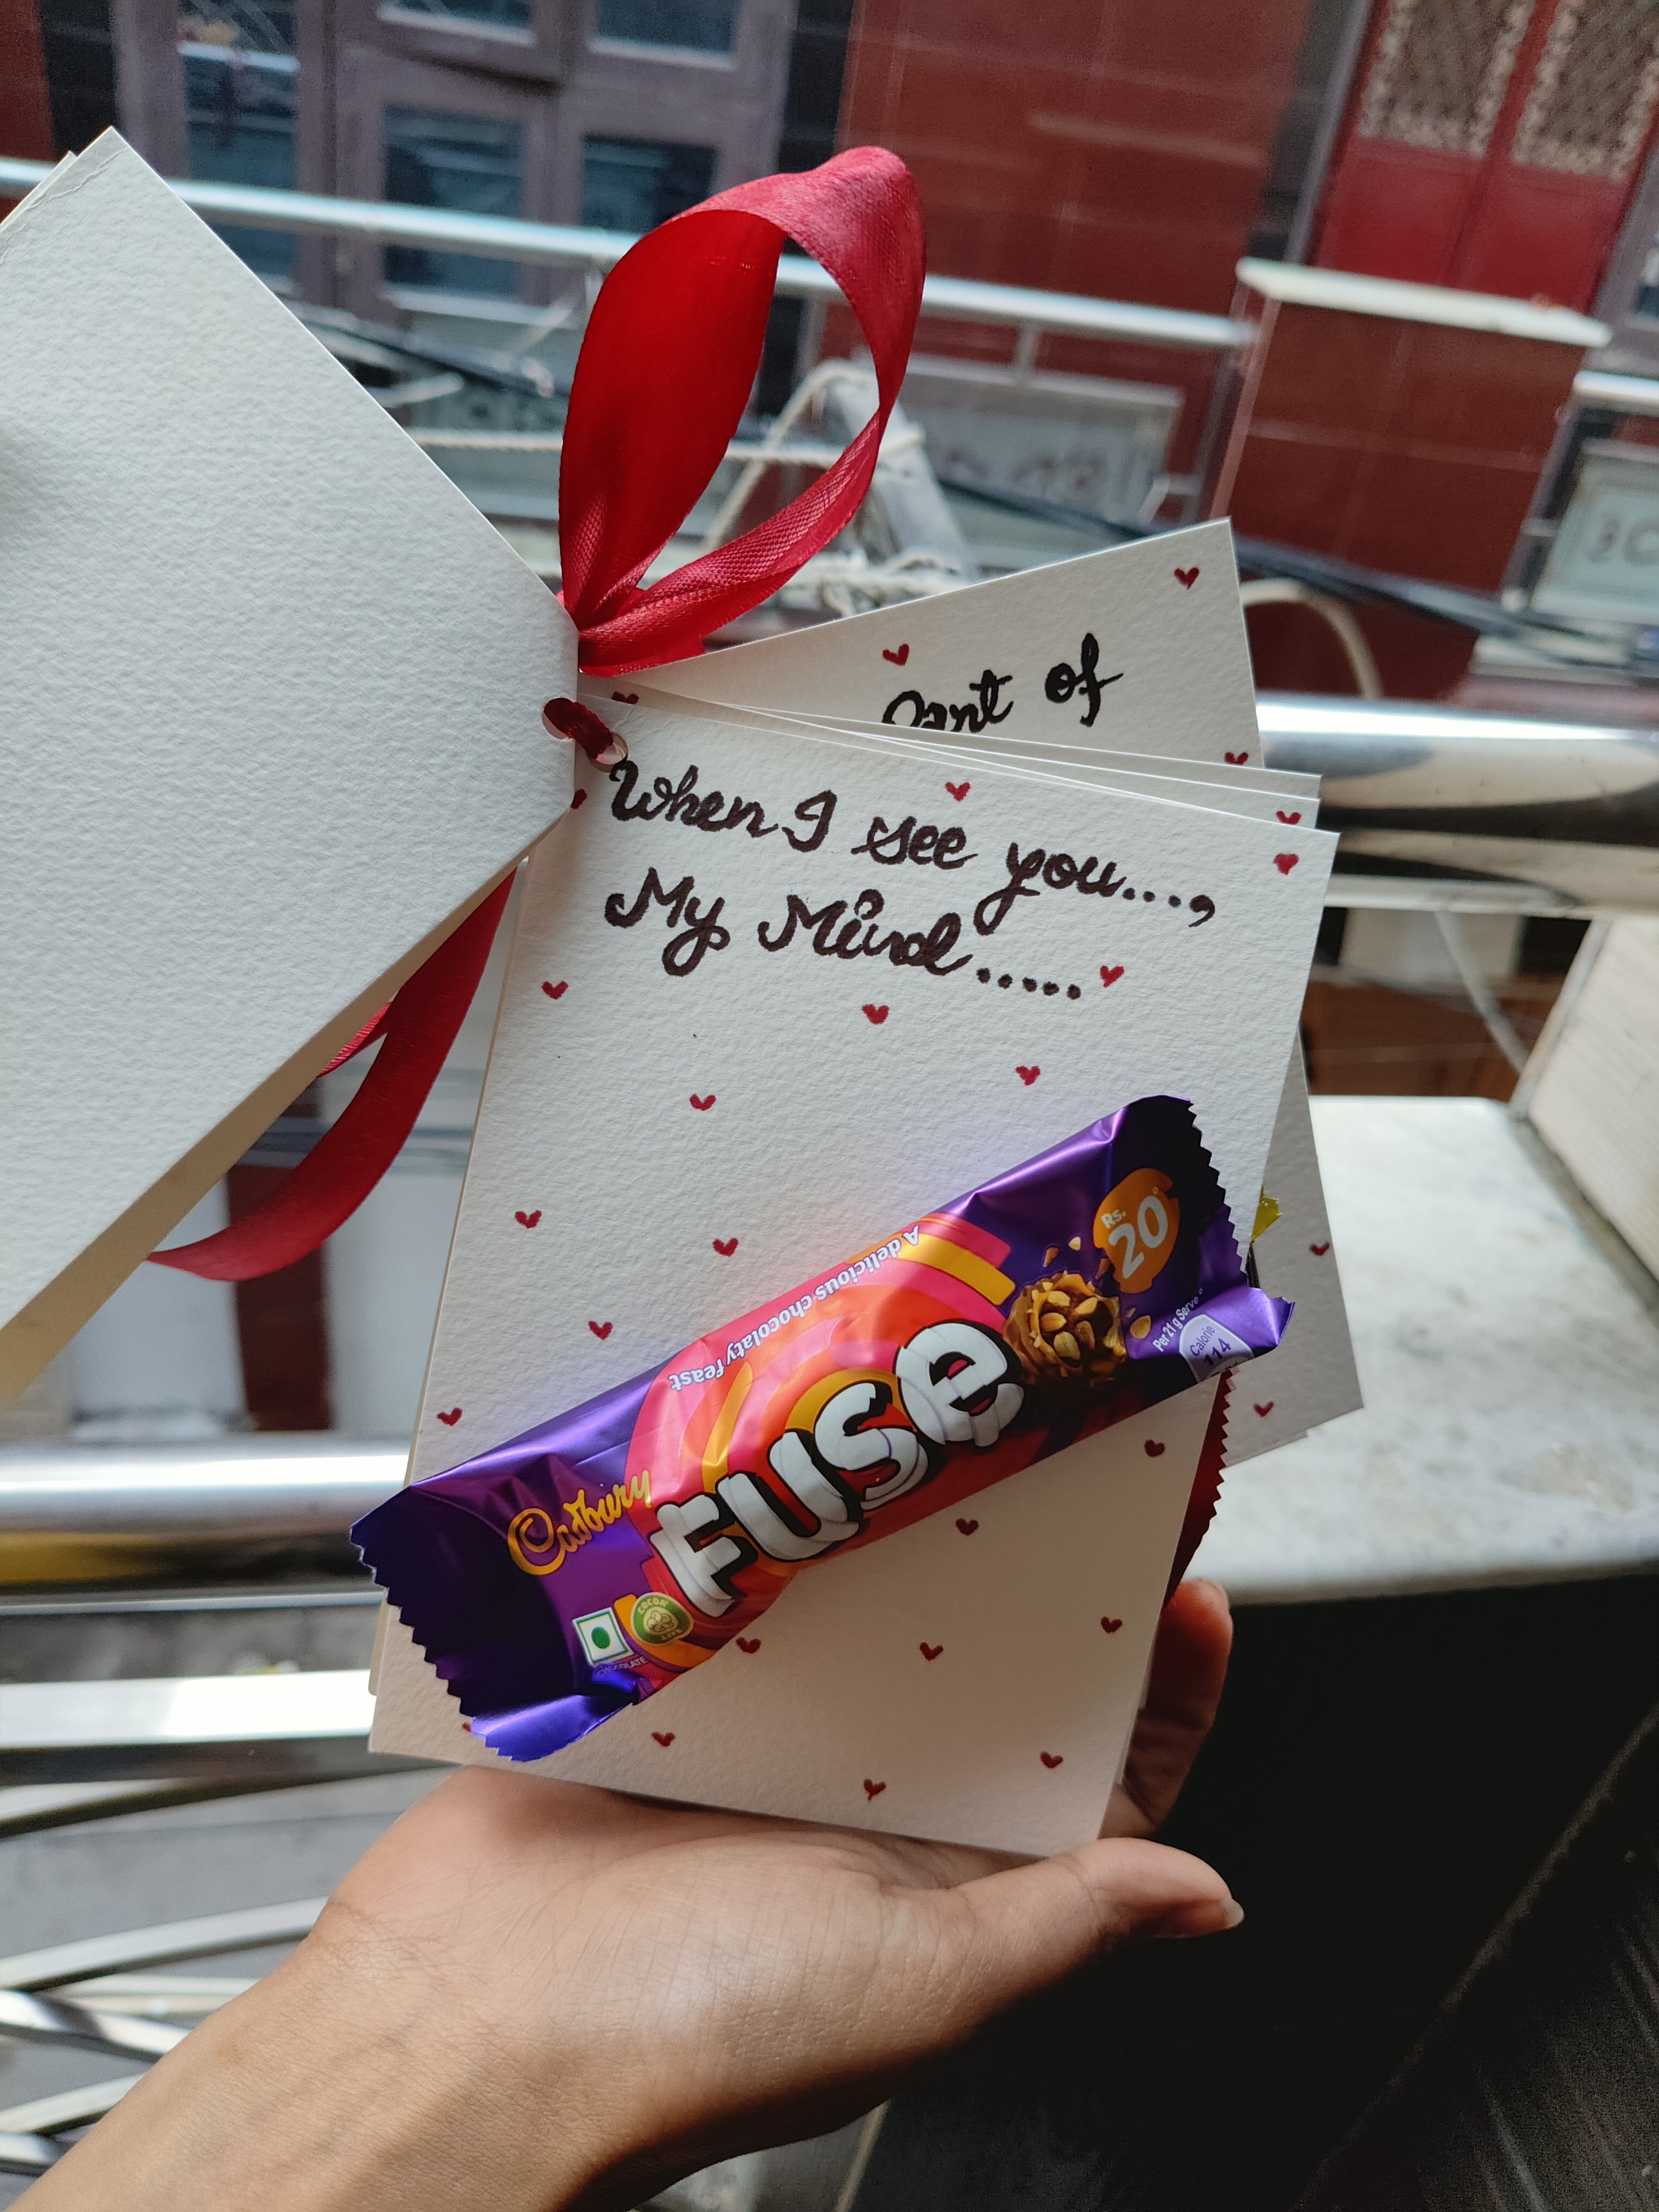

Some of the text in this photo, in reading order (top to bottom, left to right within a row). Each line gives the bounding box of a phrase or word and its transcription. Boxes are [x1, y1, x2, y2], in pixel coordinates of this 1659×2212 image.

[1044, 633, 1124, 727] of
[609, 758, 779, 838] When
[782, 790, 838, 853] I
[851, 816, 978, 870] see
[604, 867, 731, 977] My
[1101, 1195, 1168, 1280] Rs. 20
[668, 1225, 921, 1391] A delicious chocolaty feast
[1152, 1296, 1199, 1352] Per 21 g Serve
[1190, 1325, 1216, 1357] Calorie
[1203, 1337, 1232, 1366] 114
[508, 1469, 652, 1576] Cadbury
